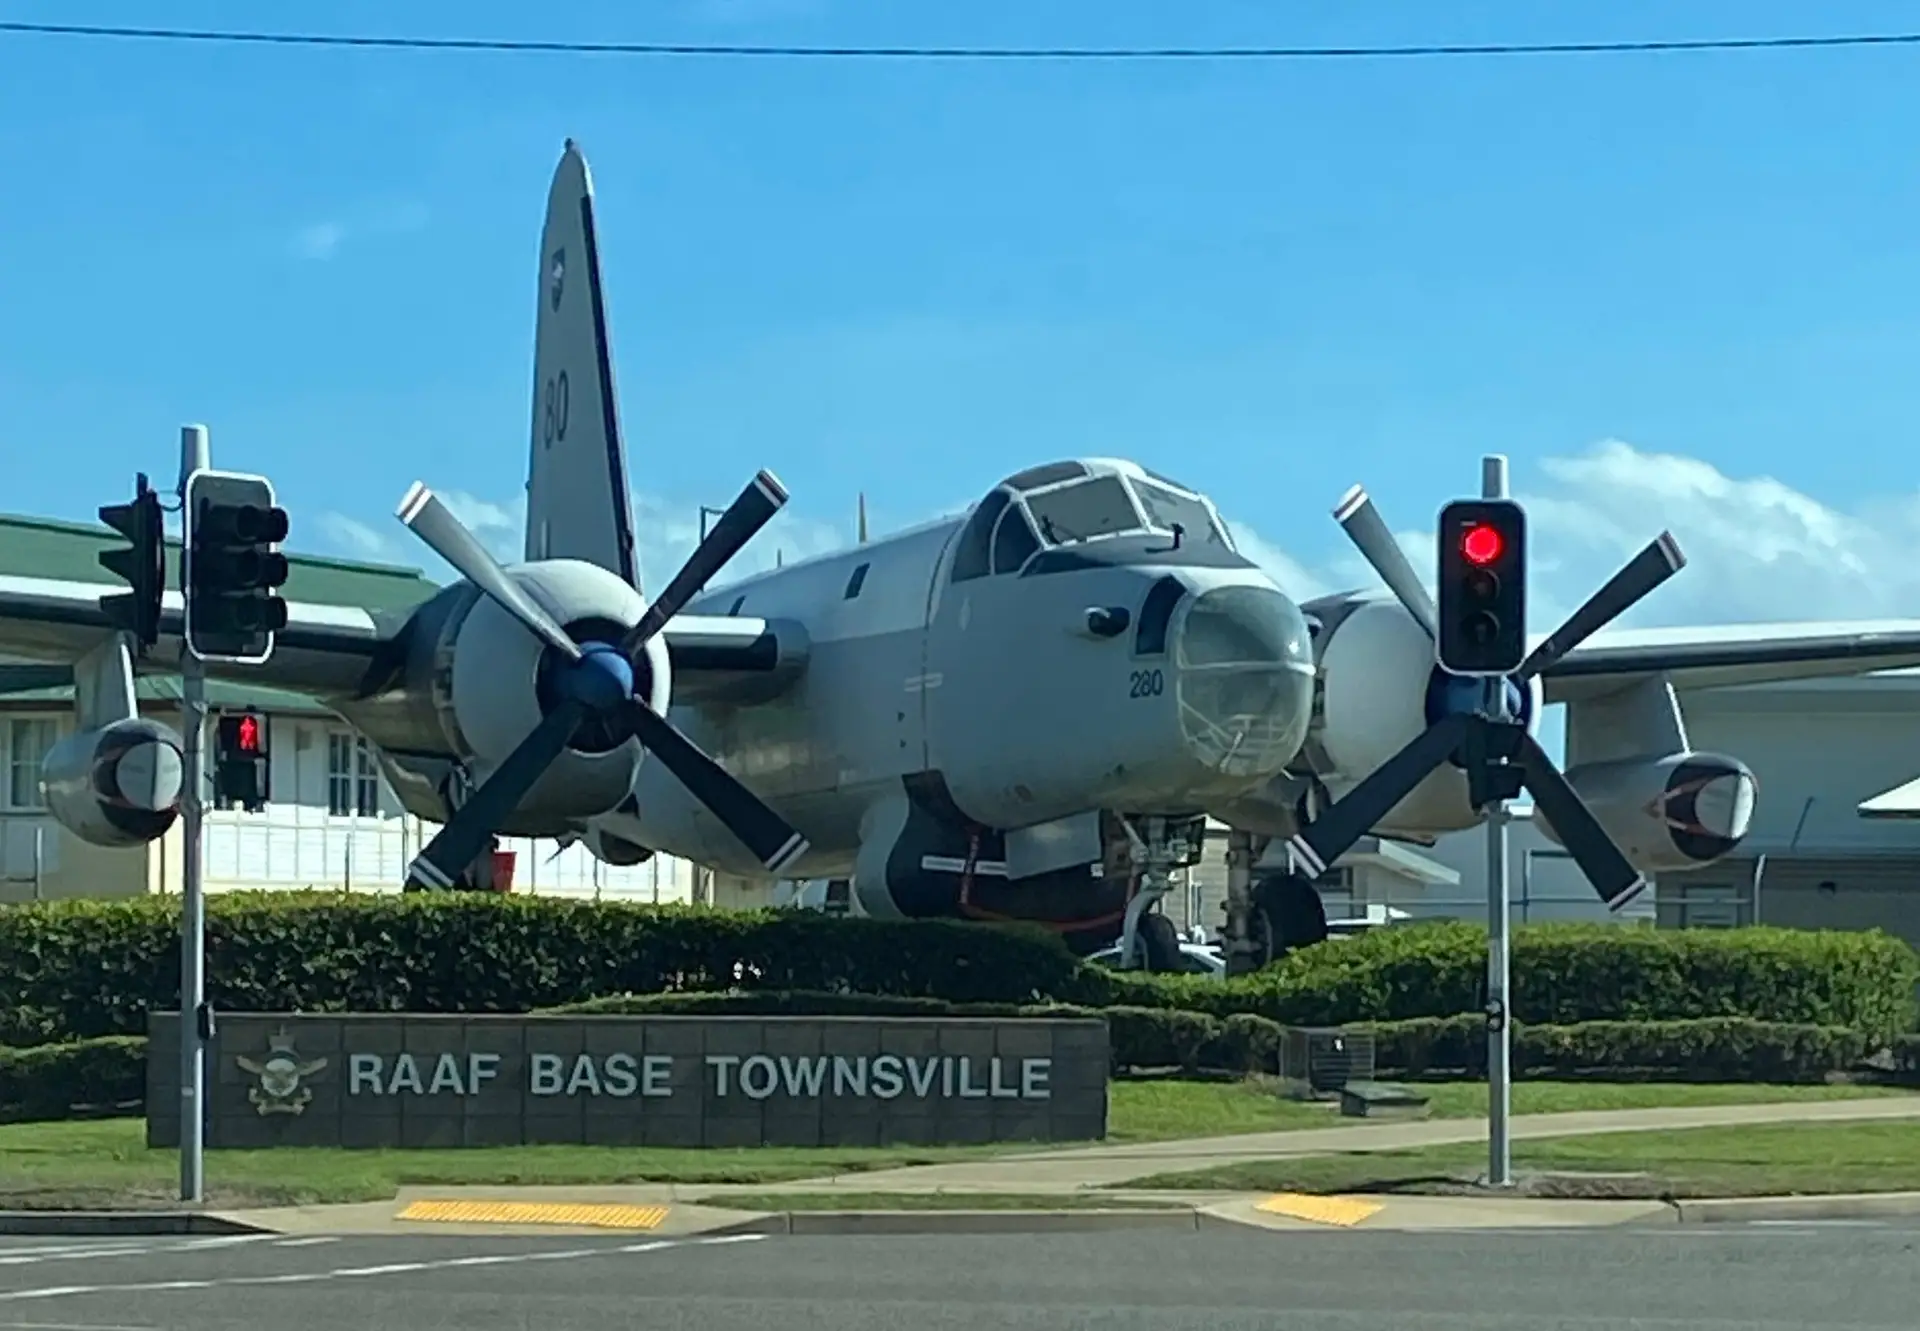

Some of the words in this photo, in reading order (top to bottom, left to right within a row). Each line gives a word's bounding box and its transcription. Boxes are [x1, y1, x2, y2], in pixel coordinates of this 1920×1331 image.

[544, 368, 569, 450] 80
[1129, 668, 1164, 699] 280
[349, 1052, 502, 1097] RAAF
[529, 1054, 674, 1098] BASE
[706, 1054, 1053, 1102] TOWNSVILLE
